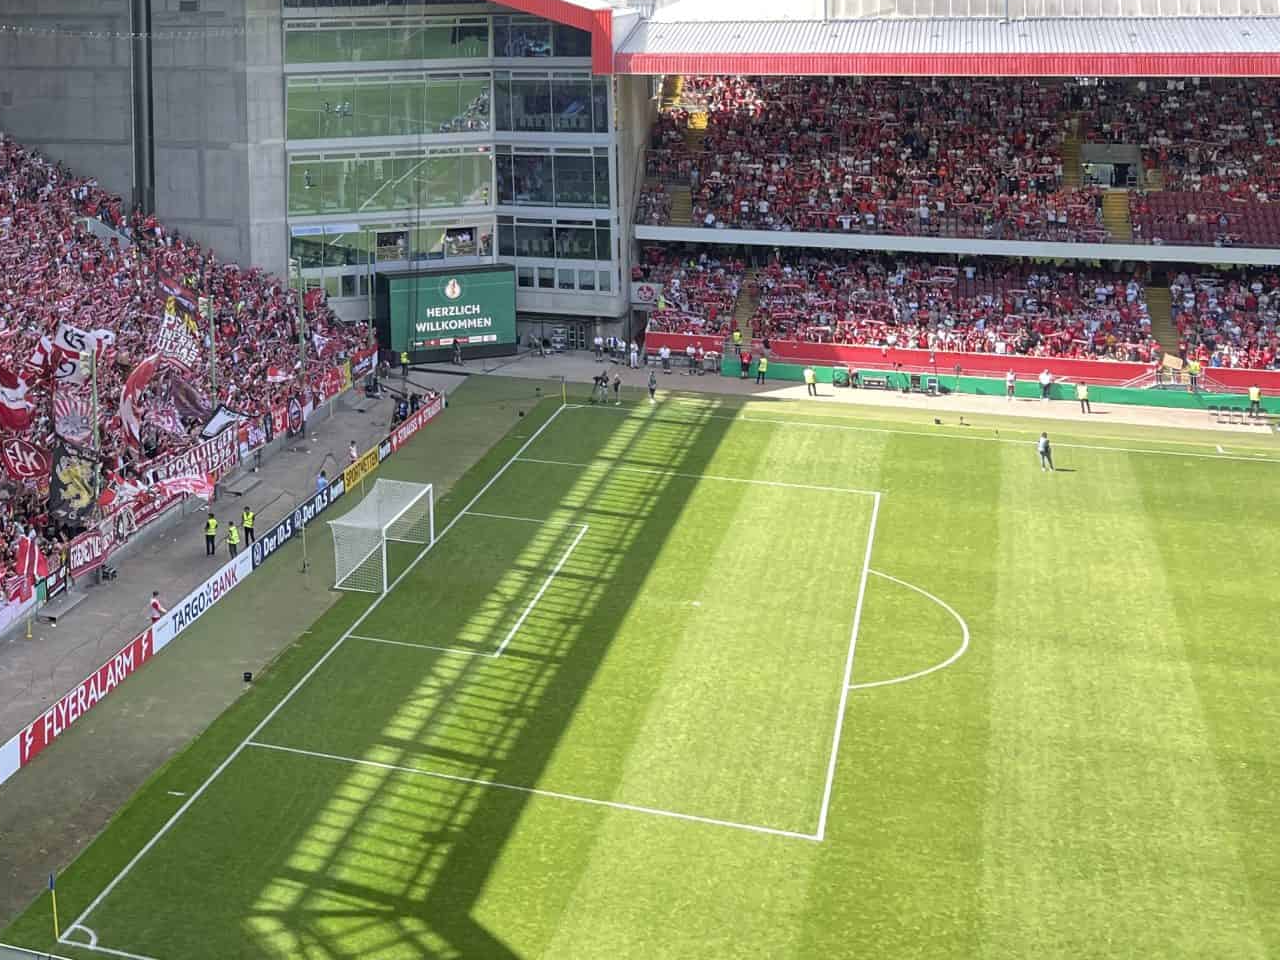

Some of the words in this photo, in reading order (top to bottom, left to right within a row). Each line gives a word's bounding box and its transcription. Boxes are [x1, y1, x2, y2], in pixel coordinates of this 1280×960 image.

[426, 304, 481, 318] HERZLICH
[415, 317, 493, 333] WILLKOMMEN
[397, 418, 418, 444] STRAUSS
[303, 504, 315, 524] Der
[263, 535, 277, 556] Der
[277, 519, 292, 544] ID.5
[44, 645, 135, 744] FLYERALARM
